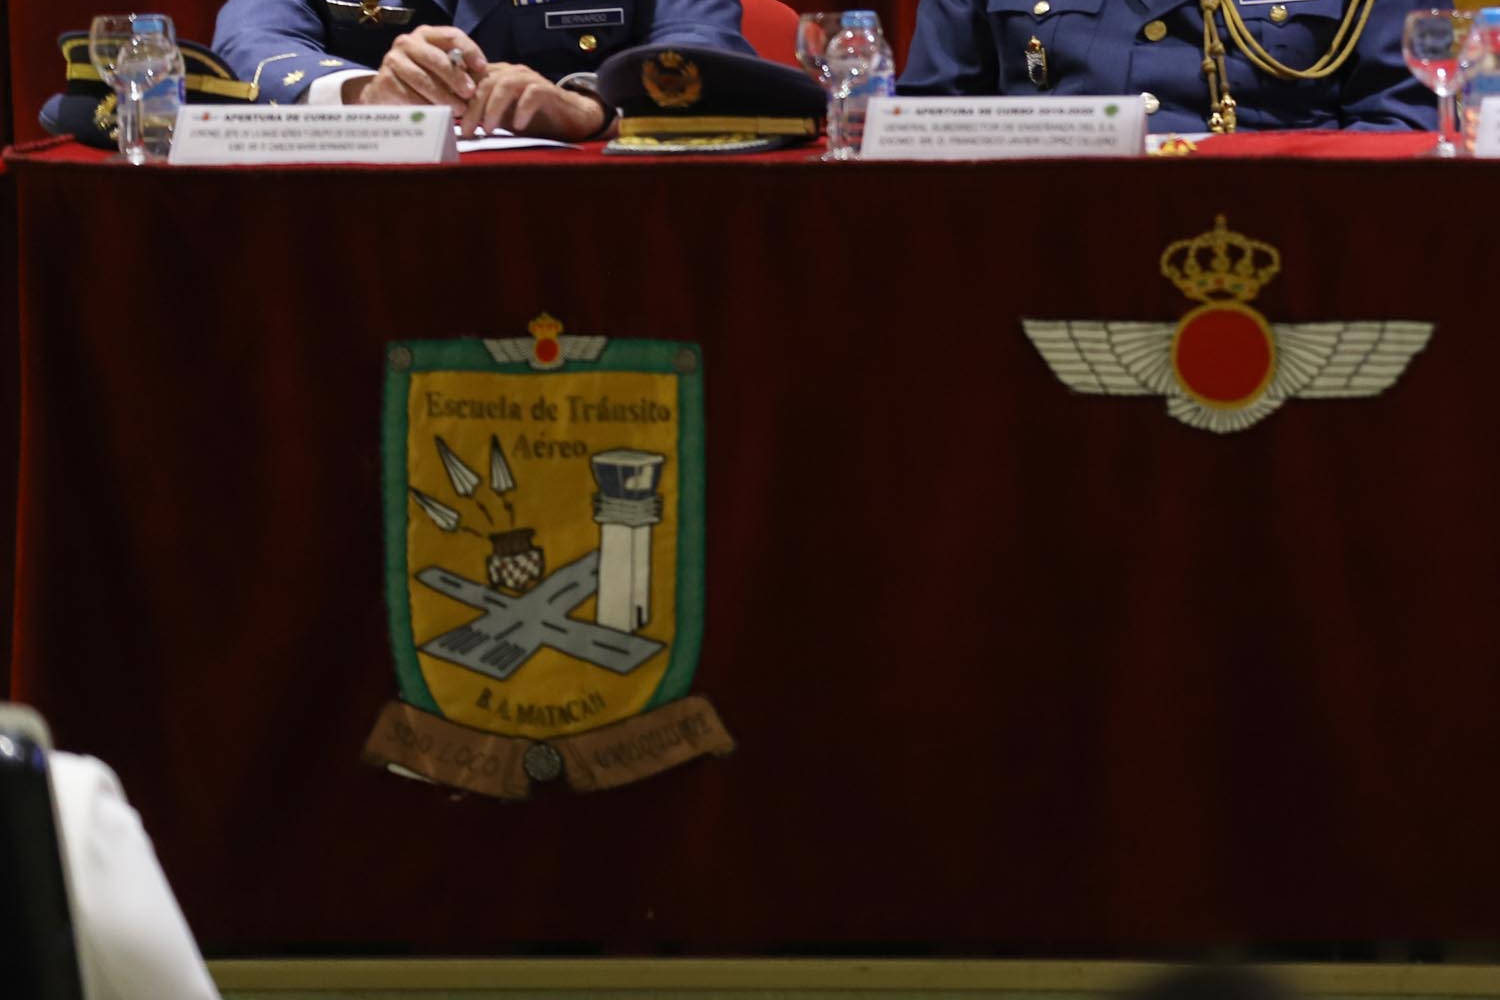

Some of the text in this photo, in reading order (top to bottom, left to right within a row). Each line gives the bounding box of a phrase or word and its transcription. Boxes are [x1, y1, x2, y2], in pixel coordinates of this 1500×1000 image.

[224, 113, 282, 122] APERTURA
[286, 113, 300, 122] DE
[303, 113, 342, 122] CURSO
[426, 391, 671, 425] Escuela de Tránsito
[512, 429, 588, 459] Aéreo
